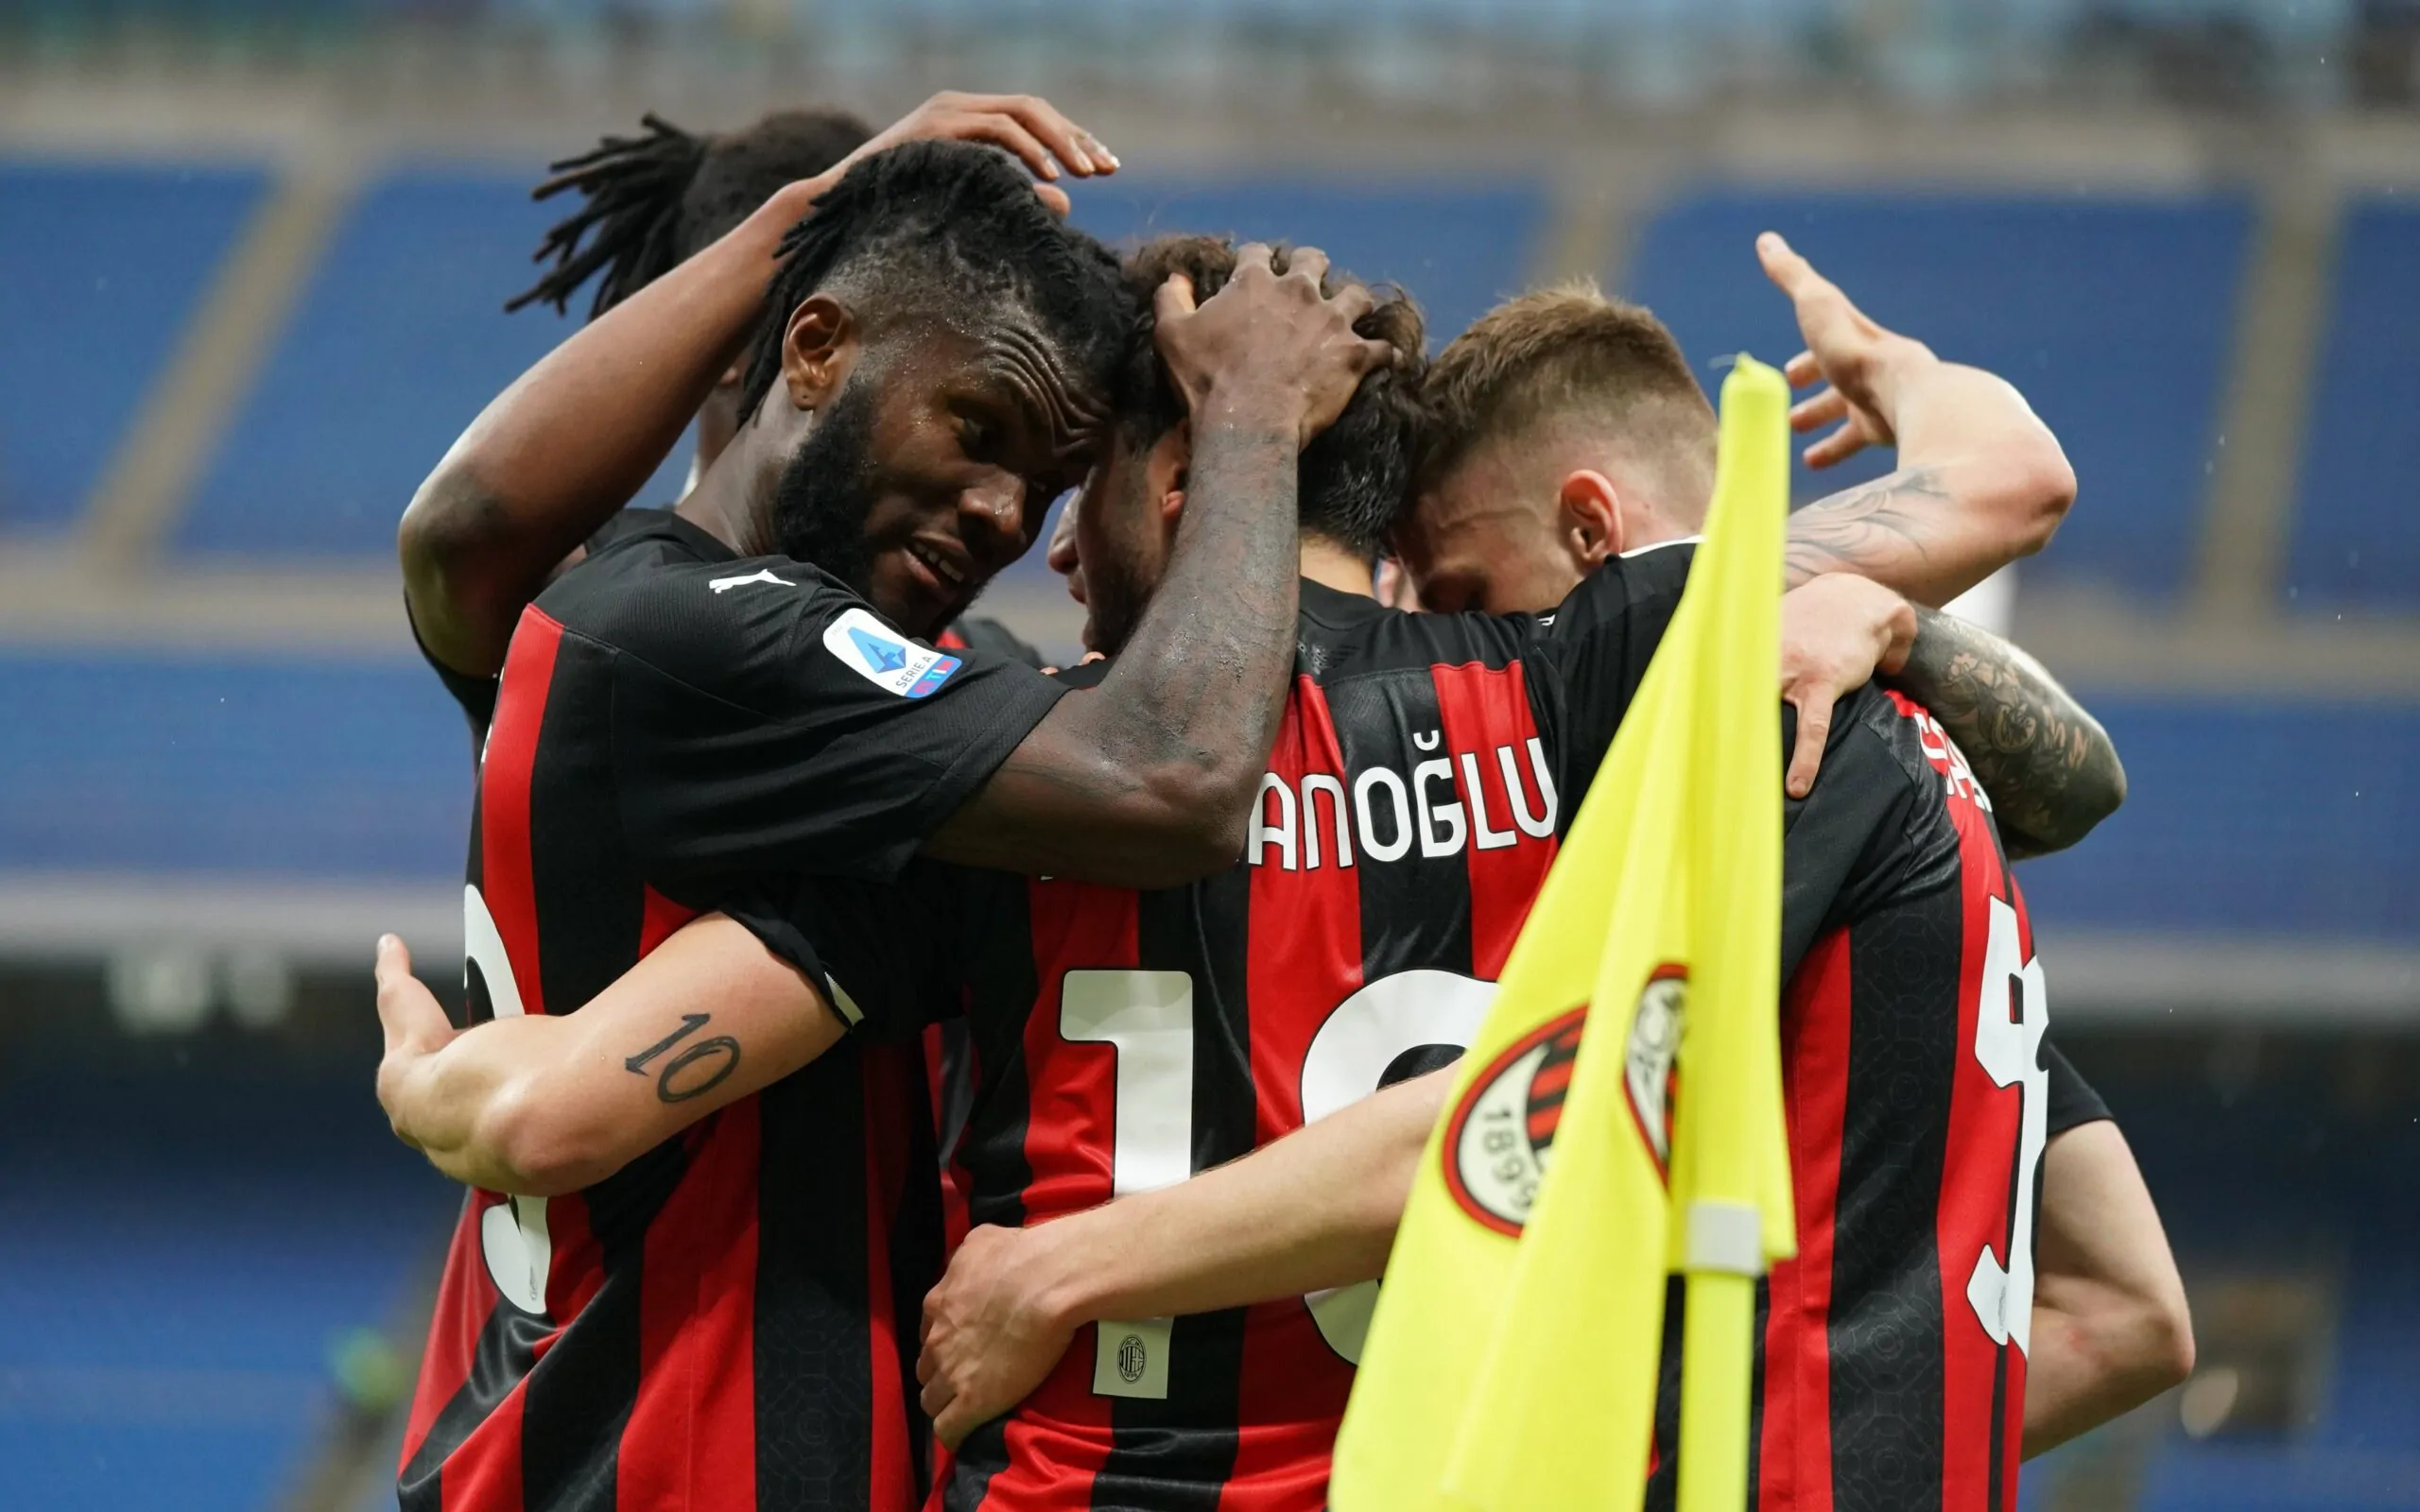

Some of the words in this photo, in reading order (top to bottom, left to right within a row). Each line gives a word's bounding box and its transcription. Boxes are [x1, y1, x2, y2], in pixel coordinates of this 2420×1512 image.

[895, 662, 925, 689] SERIE
[921, 656, 932, 668] A
[1248, 730, 1559, 870] ANOĞLU
[625, 1012, 741, 1105] 10
